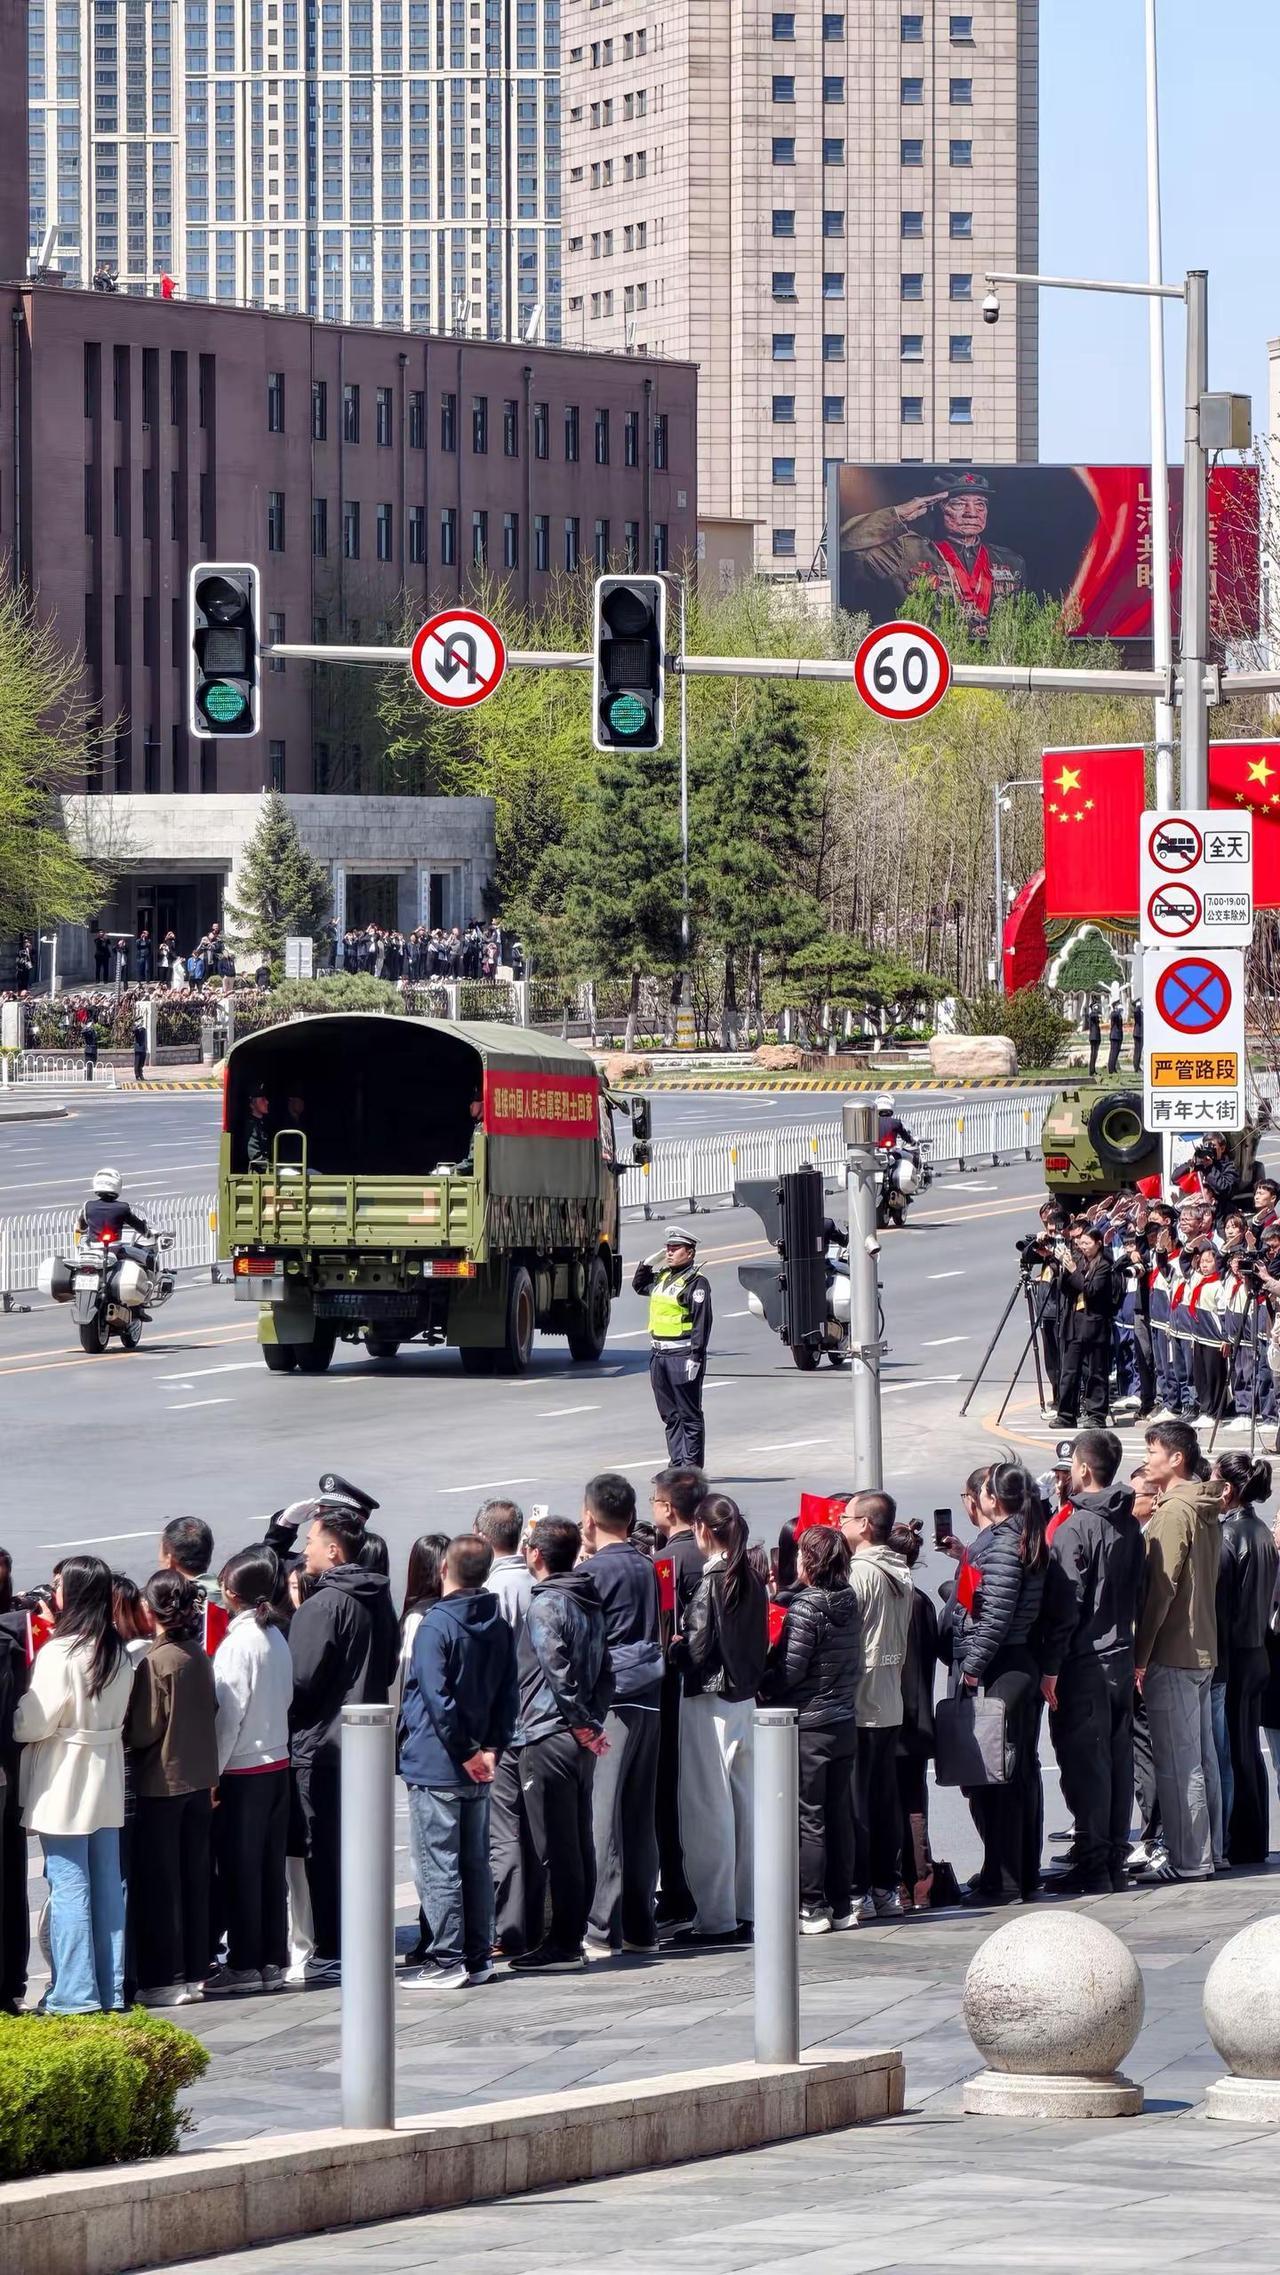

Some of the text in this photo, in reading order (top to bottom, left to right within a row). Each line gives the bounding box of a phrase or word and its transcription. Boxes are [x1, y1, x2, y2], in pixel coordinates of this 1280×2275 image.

[873, 647, 928, 694] 60
[1210, 836, 1243, 858] 全天
[1207, 909, 1247, 921] 公交车除外
[1154, 1059, 1236, 1081] 严管路段
[1153, 1099, 1236, 1121] 青年大街
